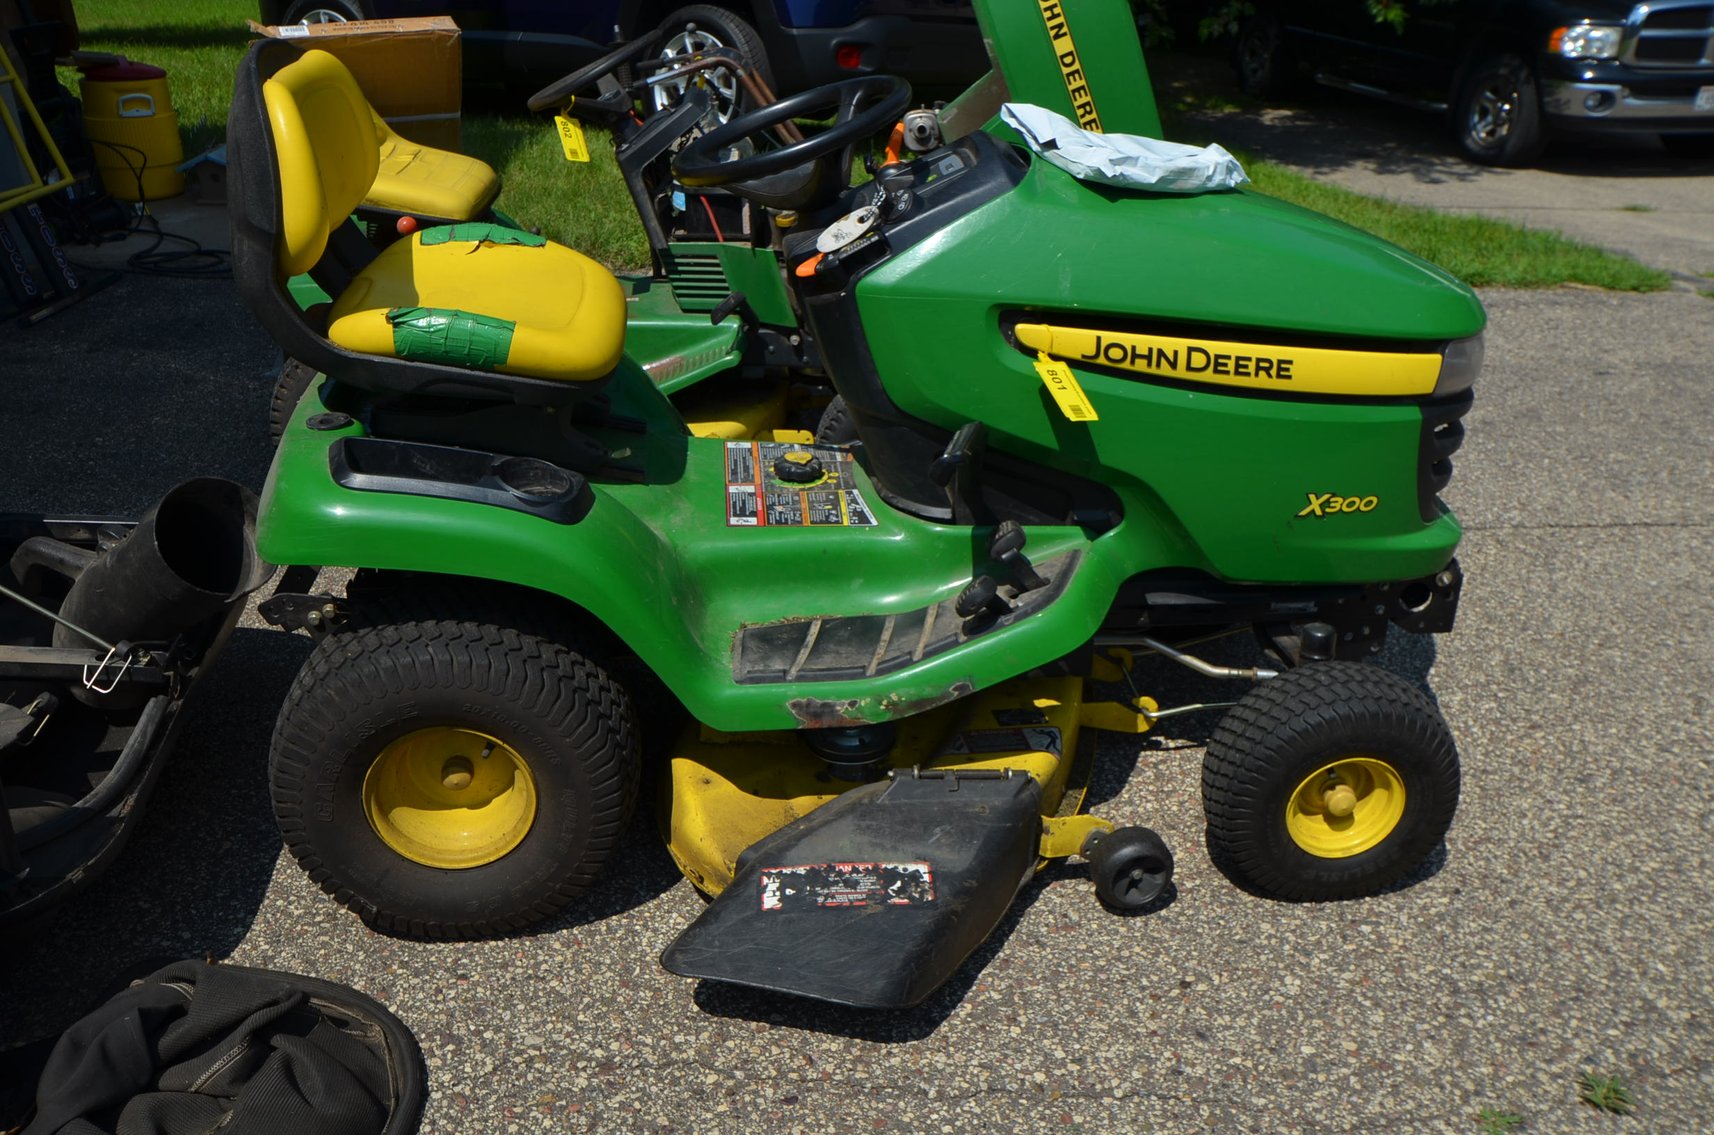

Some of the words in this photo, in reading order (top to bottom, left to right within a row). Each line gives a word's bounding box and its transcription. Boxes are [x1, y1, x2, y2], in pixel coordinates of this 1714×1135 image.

[1040, 0, 1068, 41] HN
[1059, 50, 1100, 132] DEERE
[560, 120, 573, 139] 802
[1081, 335, 1179, 372] JOHN
[1185, 346, 1294, 380] DEERE
[1046, 369, 1068, 391] 801
[1297, 493, 1378, 517] X300
[314, 700, 419, 822] CARLISLE
